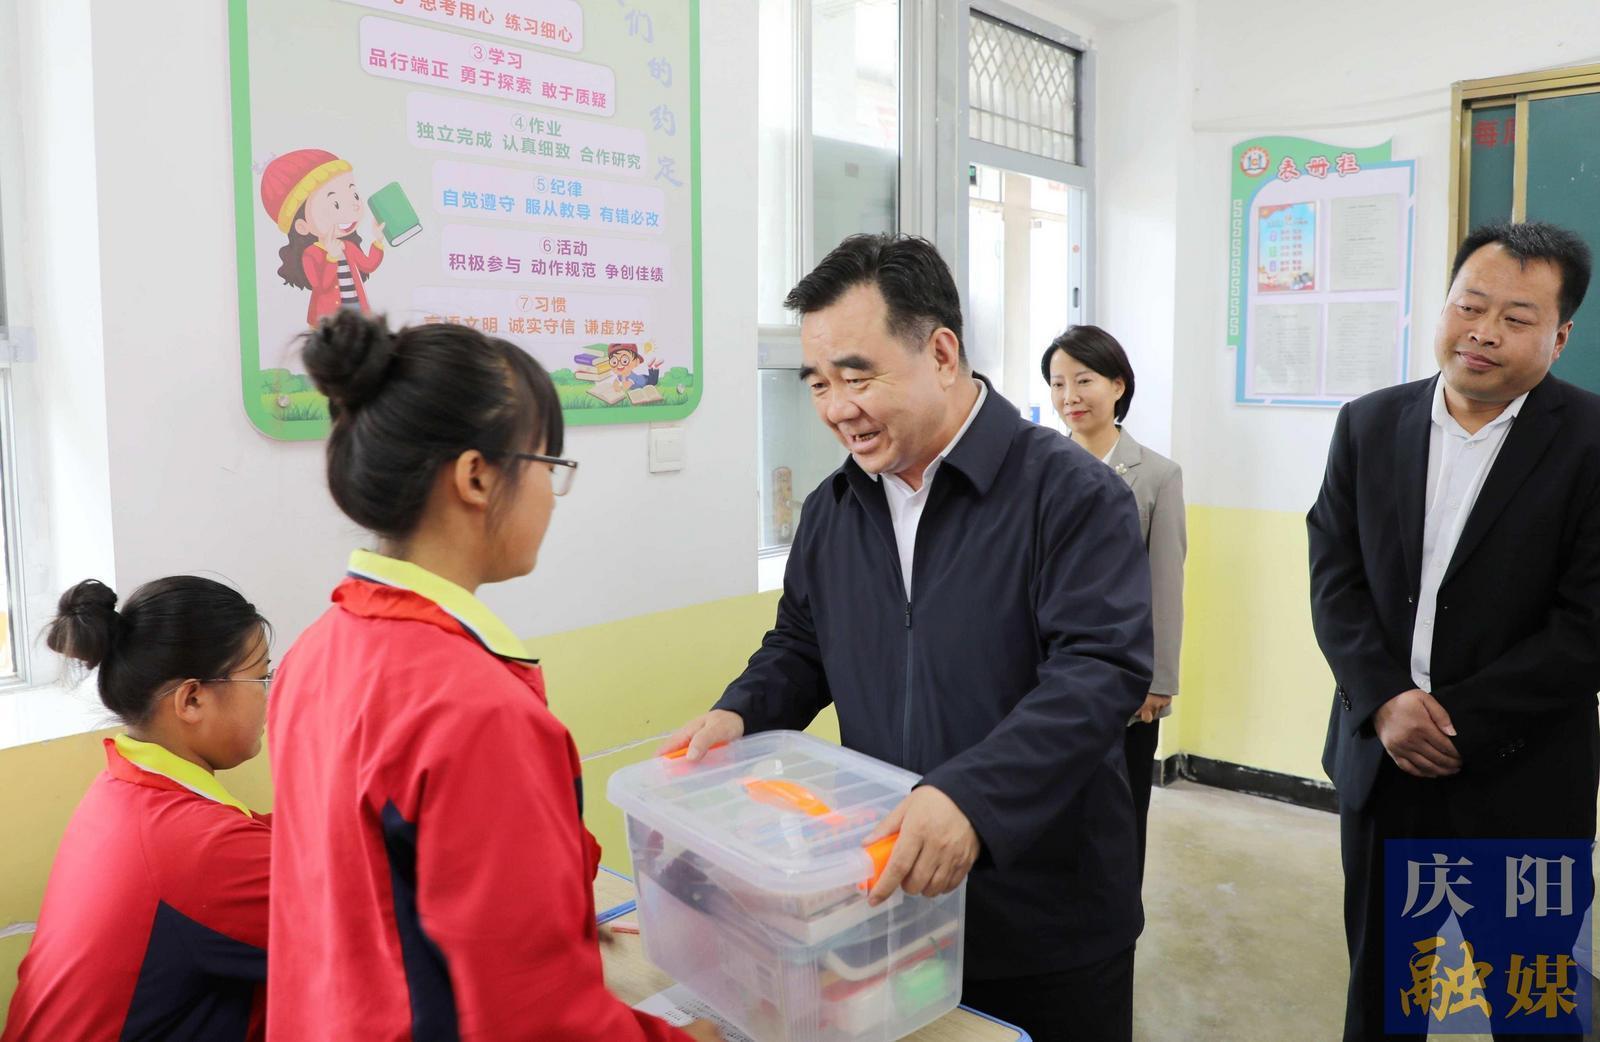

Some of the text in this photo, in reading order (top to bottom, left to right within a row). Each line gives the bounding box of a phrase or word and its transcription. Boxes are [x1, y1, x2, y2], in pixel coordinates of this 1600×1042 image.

[505, 13, 573, 43] 练习细心
[369, 47, 607, 109] 品行端正 勇于探索 敢于质疑
[416, 121, 641, 170] 独立完成 认真细致 合作研究
[1278, 154, 1359, 181] 表册栏
[443, 189, 659, 228] 自觉遵守 服从教导 有错必改
[449, 253, 664, 282] 积极参与 动作规范 争创佳绩
[508, 317, 575, 335] 诚实守信
[584, 319, 645, 336] 谦虚好学
